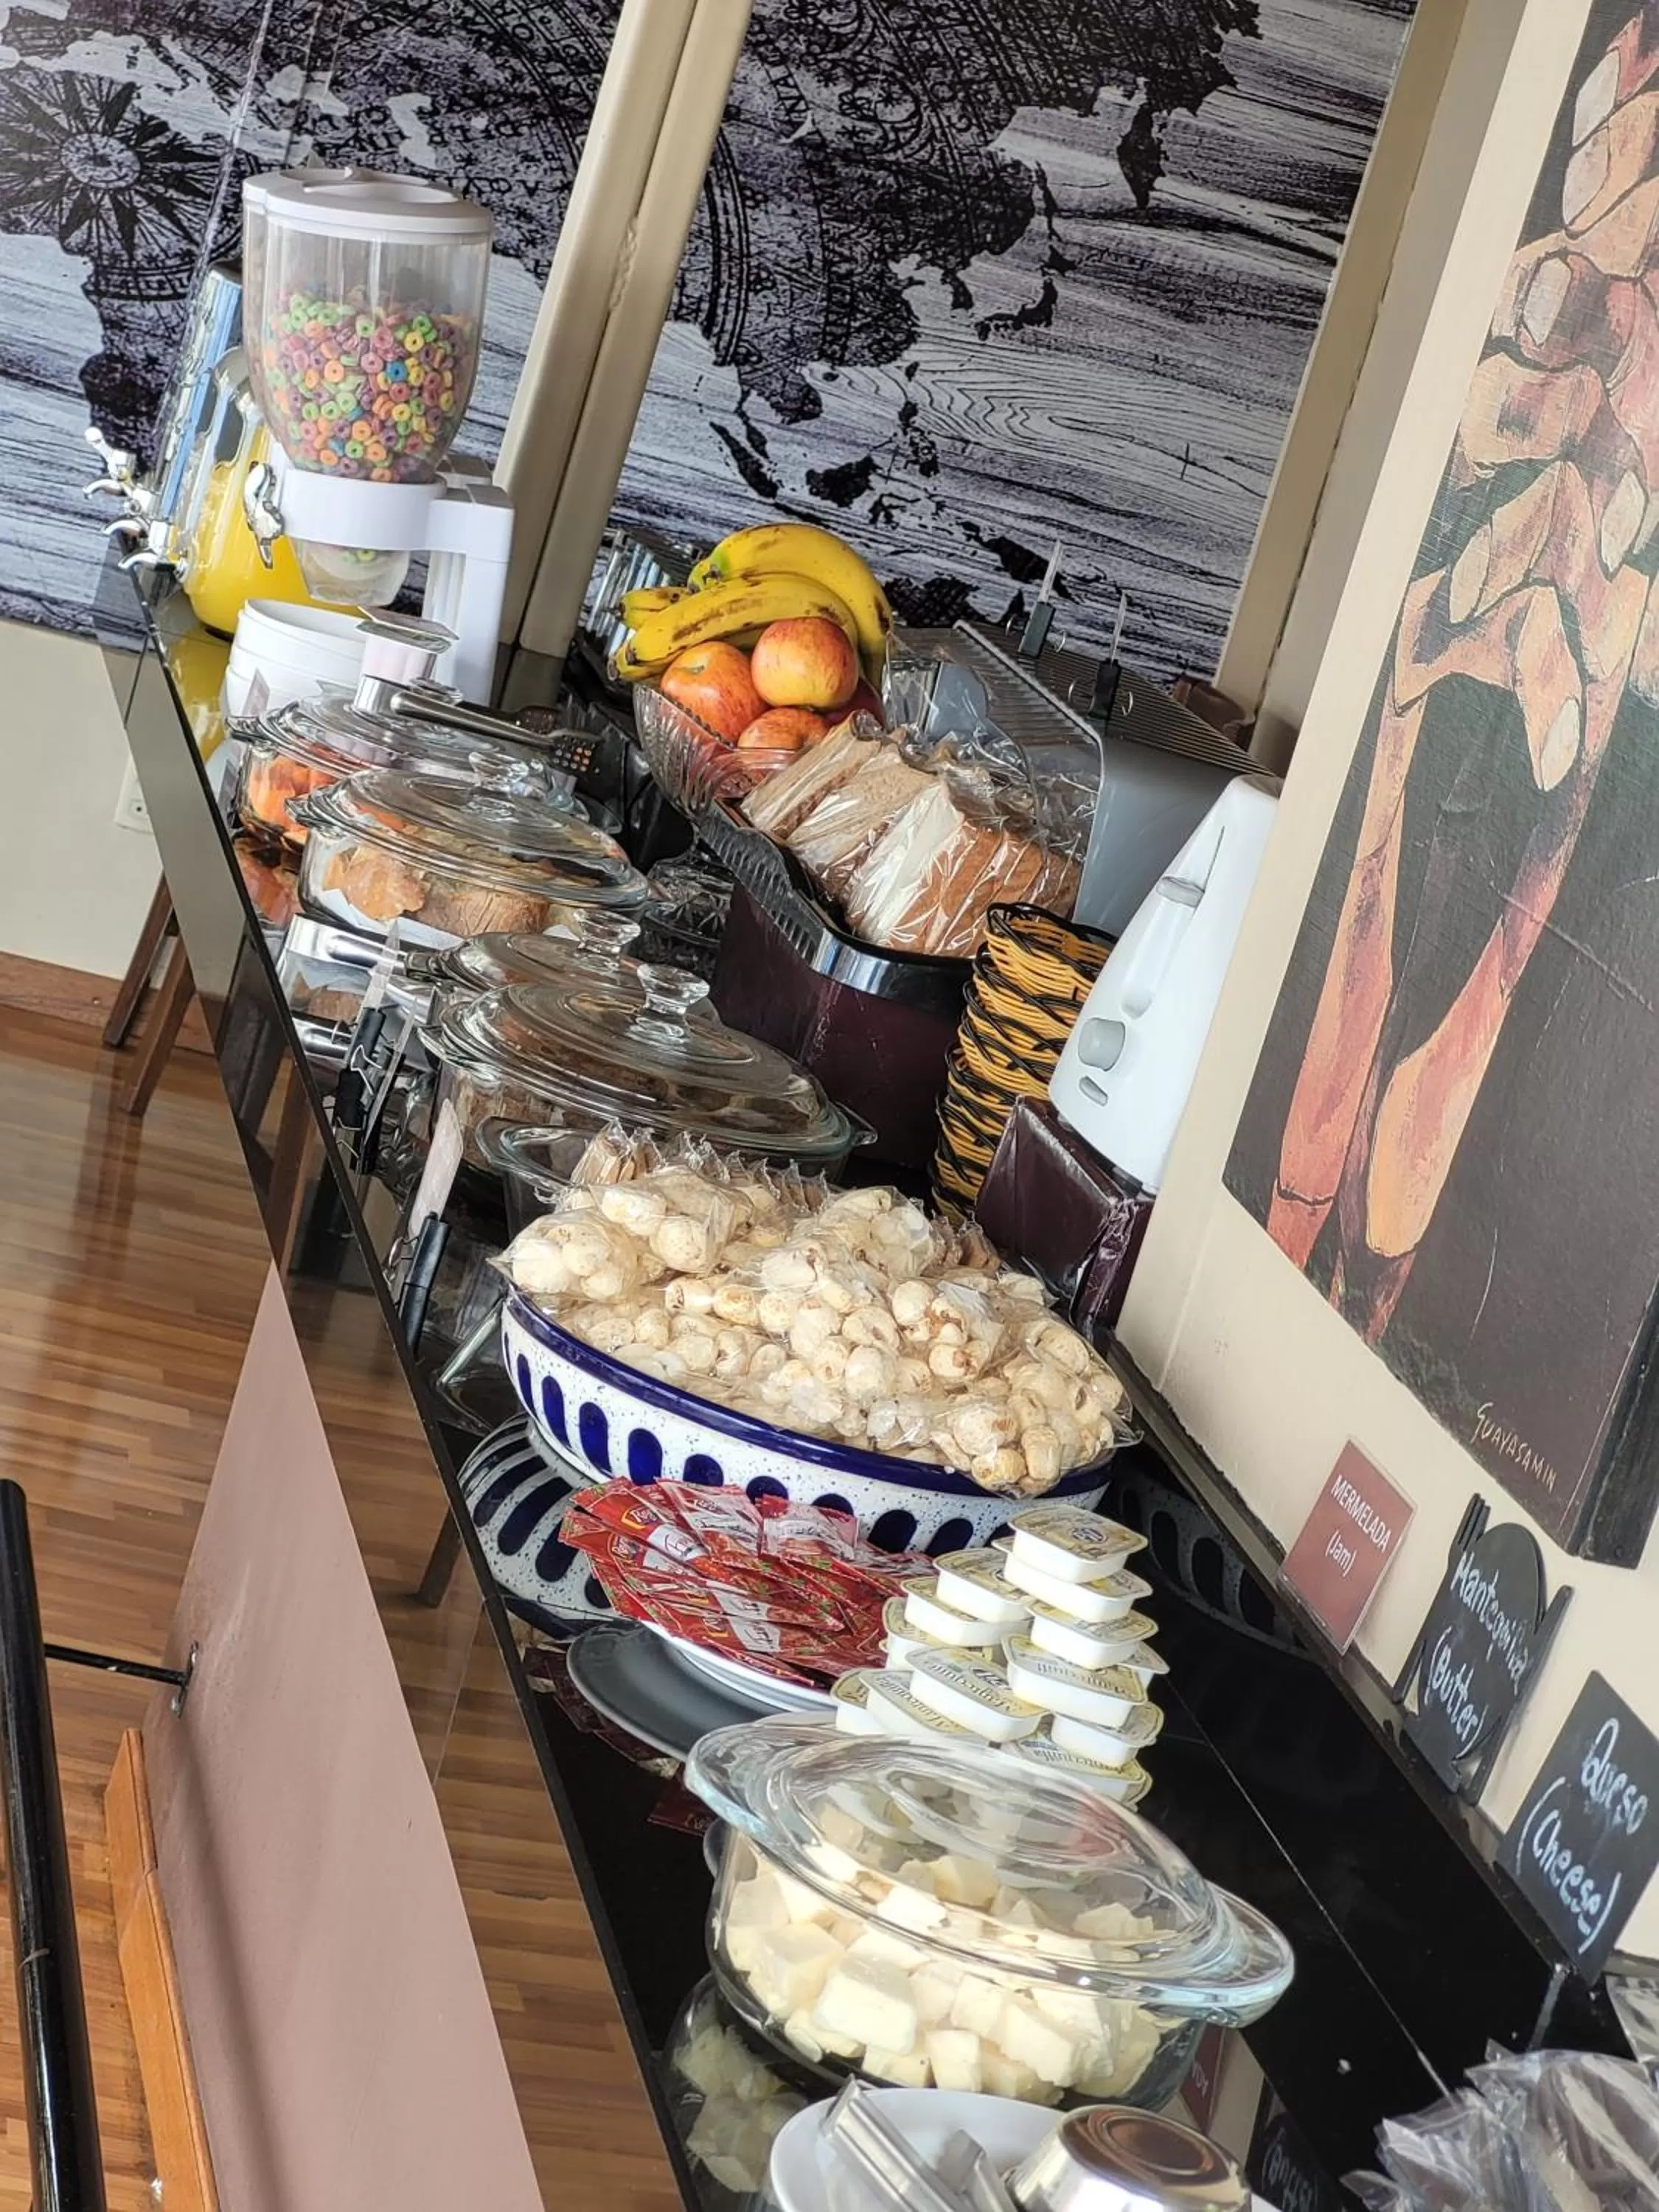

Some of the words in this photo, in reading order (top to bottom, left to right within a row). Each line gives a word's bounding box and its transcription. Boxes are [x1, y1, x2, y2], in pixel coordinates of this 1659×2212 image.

[1470, 1402, 1557, 1494] GUAYASAMIN
[1325, 1529, 1357, 1577] (Jam)
[1330, 1474, 1391, 1554] MERMELADA
[1425, 1626, 1489, 1759] (Butter)
[1581, 1717, 1649, 1835] Queso
[1516, 1775, 1622, 1955] (Cheese)
